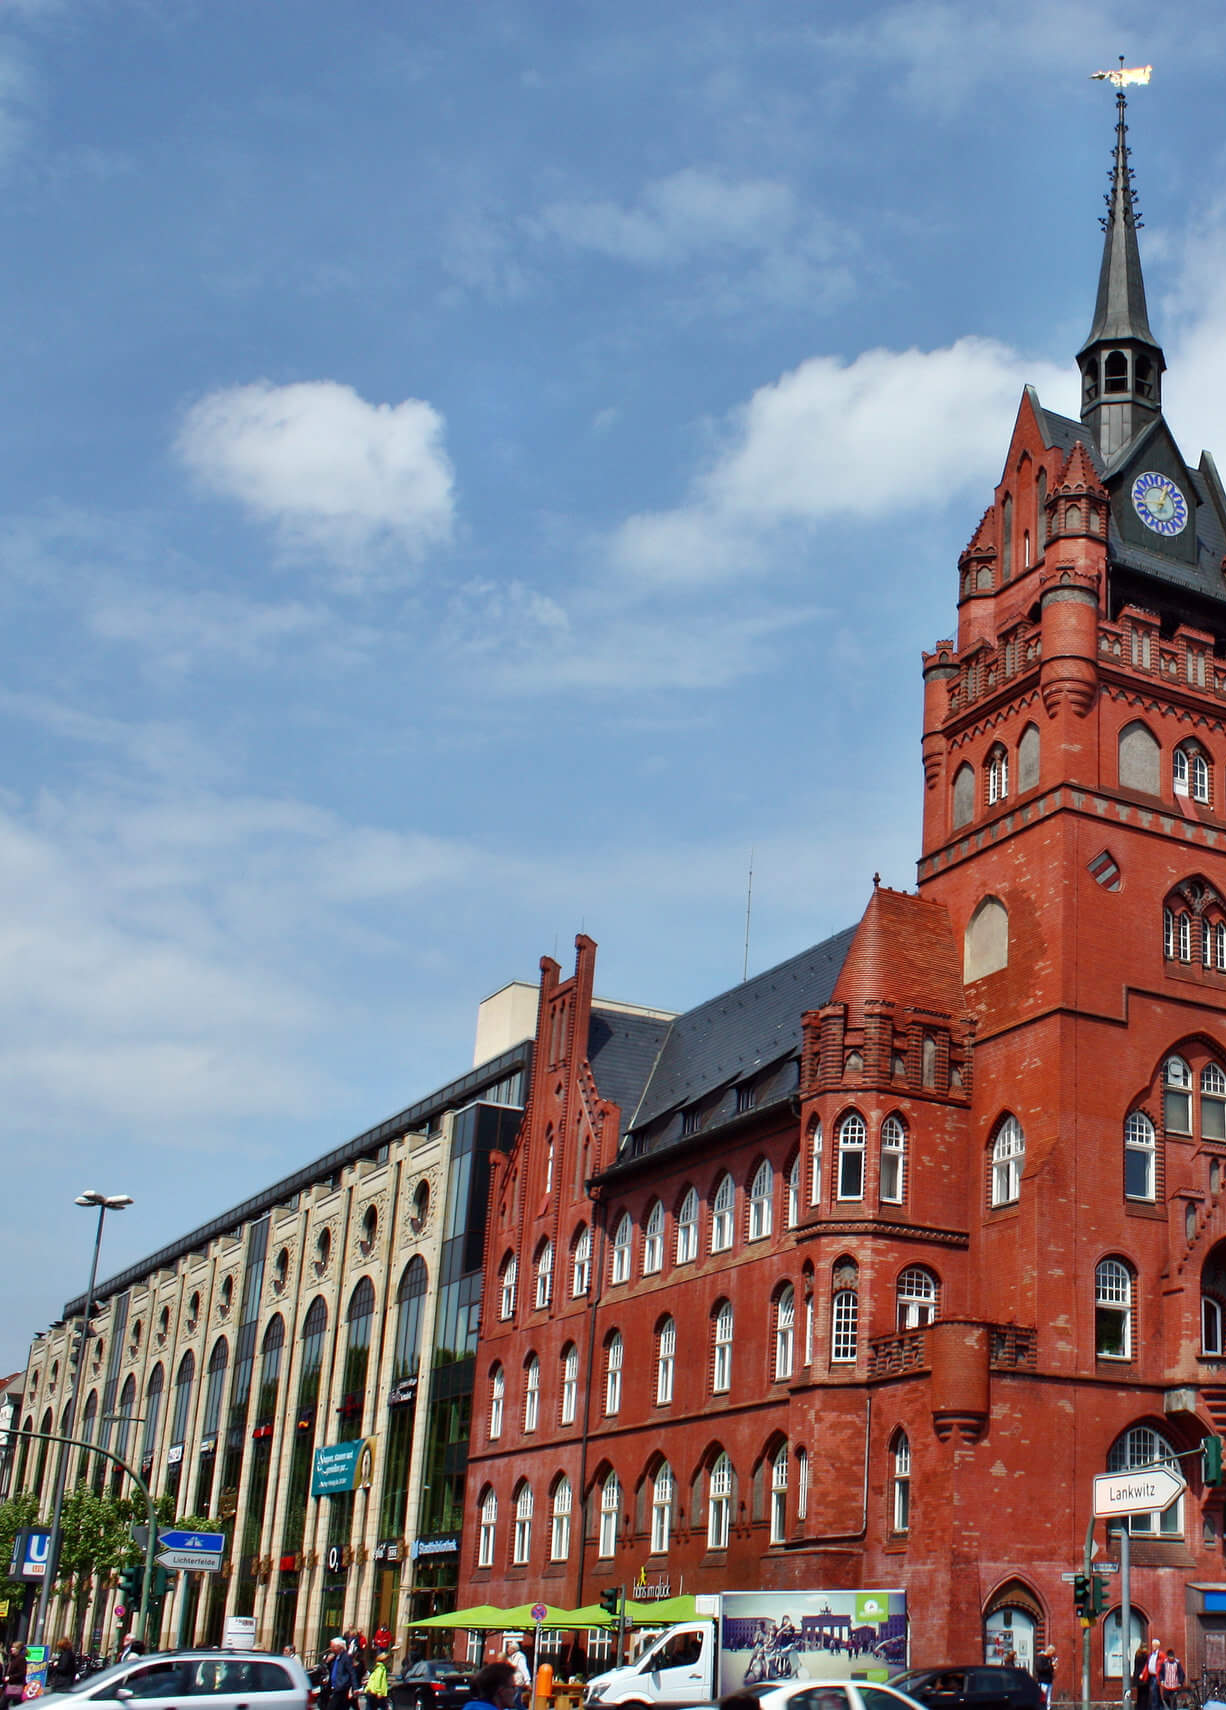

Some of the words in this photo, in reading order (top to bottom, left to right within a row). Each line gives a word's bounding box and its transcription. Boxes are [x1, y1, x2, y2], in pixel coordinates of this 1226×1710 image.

[1109, 1483, 1156, 1502] Lankwitz
[30, 1535, 51, 1562] U
[172, 1555, 217, 1566] Lichterfelde
